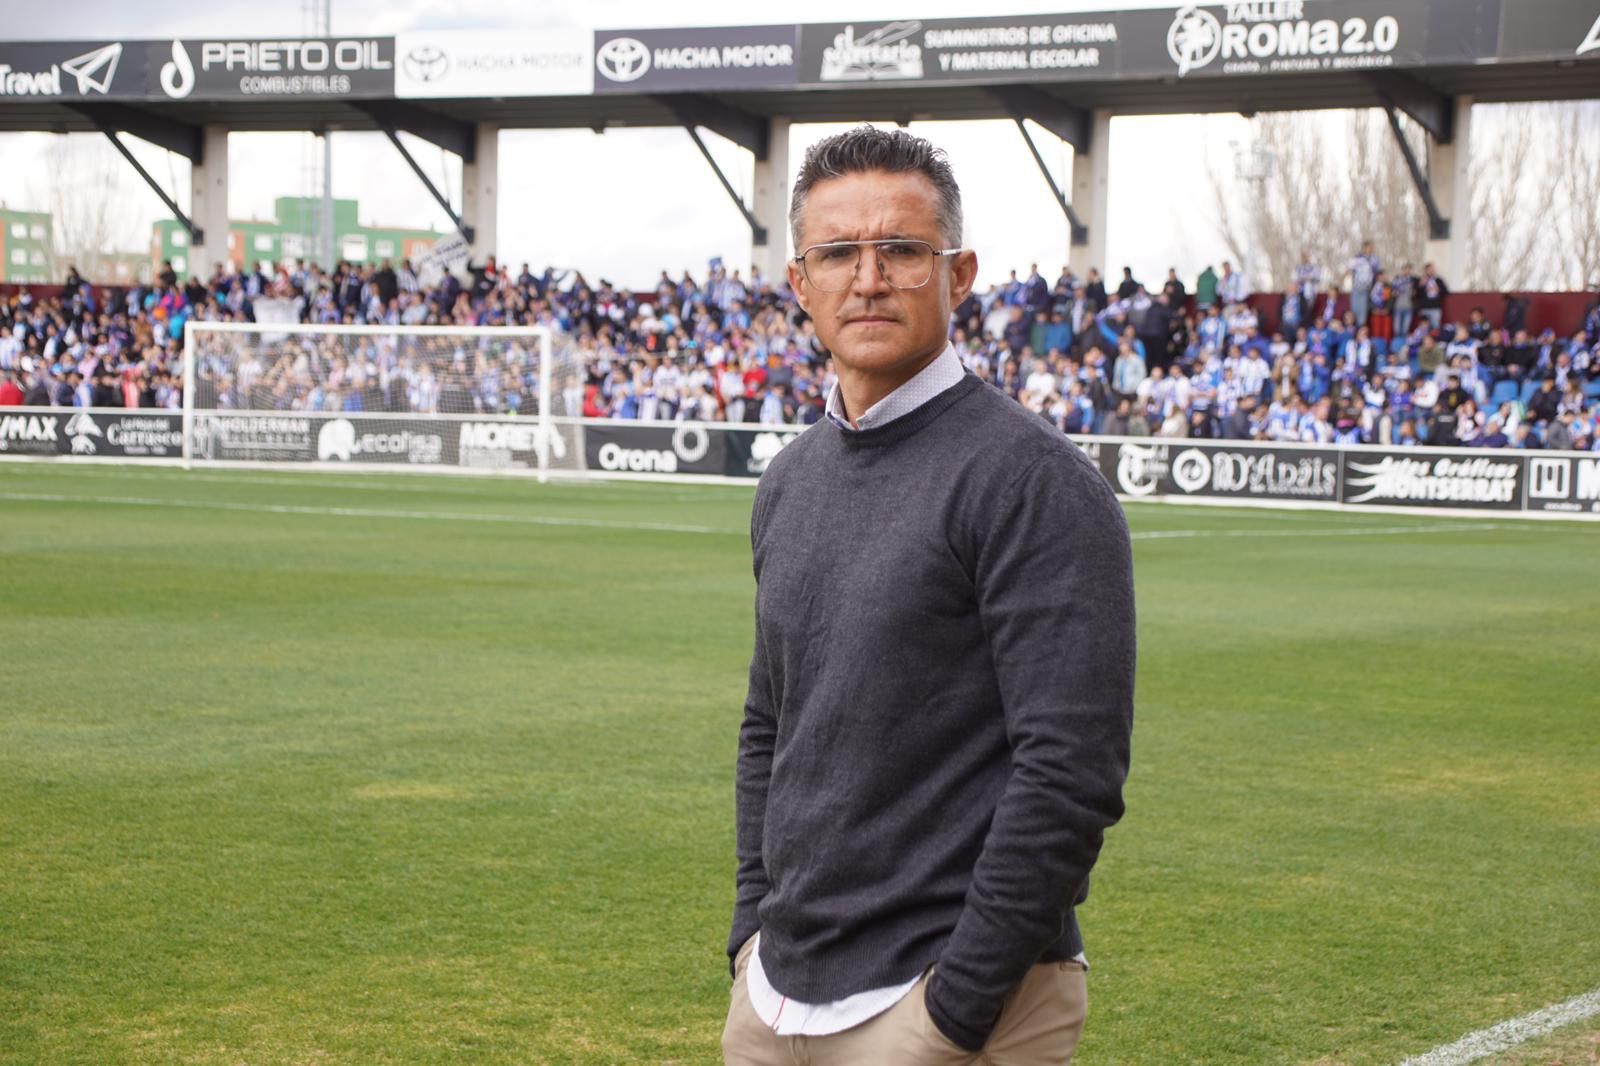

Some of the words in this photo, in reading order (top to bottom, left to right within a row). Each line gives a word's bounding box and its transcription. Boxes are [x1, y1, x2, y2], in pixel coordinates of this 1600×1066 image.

[1224, 0, 1304, 22] TALLER
[924, 27, 1027, 48] SUMINISTROS
[1029, 26, 1051, 45] DE
[1052, 23, 1118, 43] OFICINA
[202, 42, 329, 71] PRIETO
[335, 40, 392, 70] OIL
[521, 51, 585, 72] MOTOR
[654, 47, 721, 68] HACHA
[722, 44, 793, 66] MOTOR
[939, 53, 951, 71] Y
[951, 50, 1028, 71] MATERIAL
[1029, 48, 1099, 69] ESCOLAR
[0, 64, 62, 95] Travel
[240, 75, 351, 94] COMBUSTIBLES
[0, 415, 58, 441] /MAX
[598, 442, 678, 472] Orona
